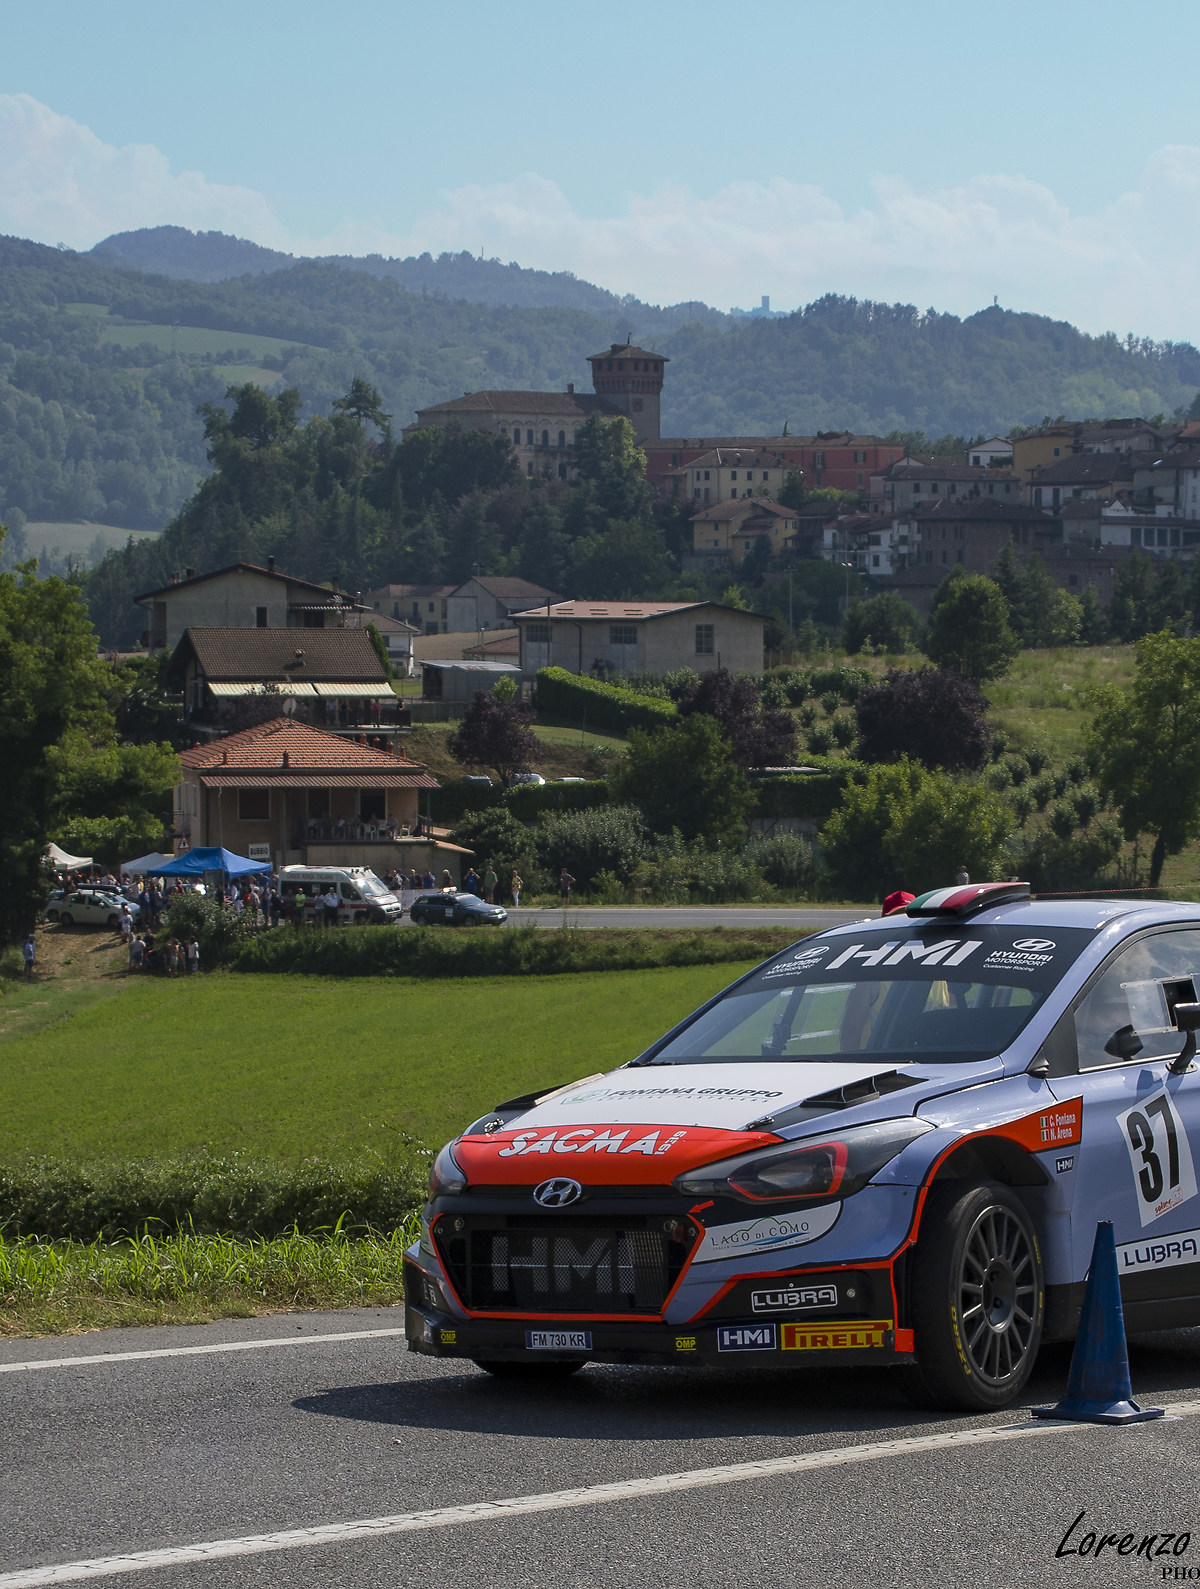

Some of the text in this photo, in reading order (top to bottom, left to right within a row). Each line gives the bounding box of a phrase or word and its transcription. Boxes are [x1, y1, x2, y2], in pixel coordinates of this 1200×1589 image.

[825, 940, 983, 970] HMI
[984, 957, 1047, 967] MOTORSPORT
[990, 950, 1053, 962] HYUNDAI
[611, 1088, 783, 1098] FONTANA GRUPPO
[499, 1128, 666, 1157] SACMA
[653, 1130, 687, 1155] 1939
[1126, 1094, 1180, 1203] 37
[1057, 1159, 1073, 1171] HMI
[711, 1231, 750, 1246] LAGO
[769, 1221, 809, 1237] COMO
[1124, 1238, 1197, 1267] LUBRA
[492, 1237, 635, 1294] HMI
[754, 1289, 835, 1306] LUBRA
[533, 1334, 585, 1346] FM 730 KR
[676, 1339, 696, 1348] OMP
[723, 1329, 770, 1345] HMI
